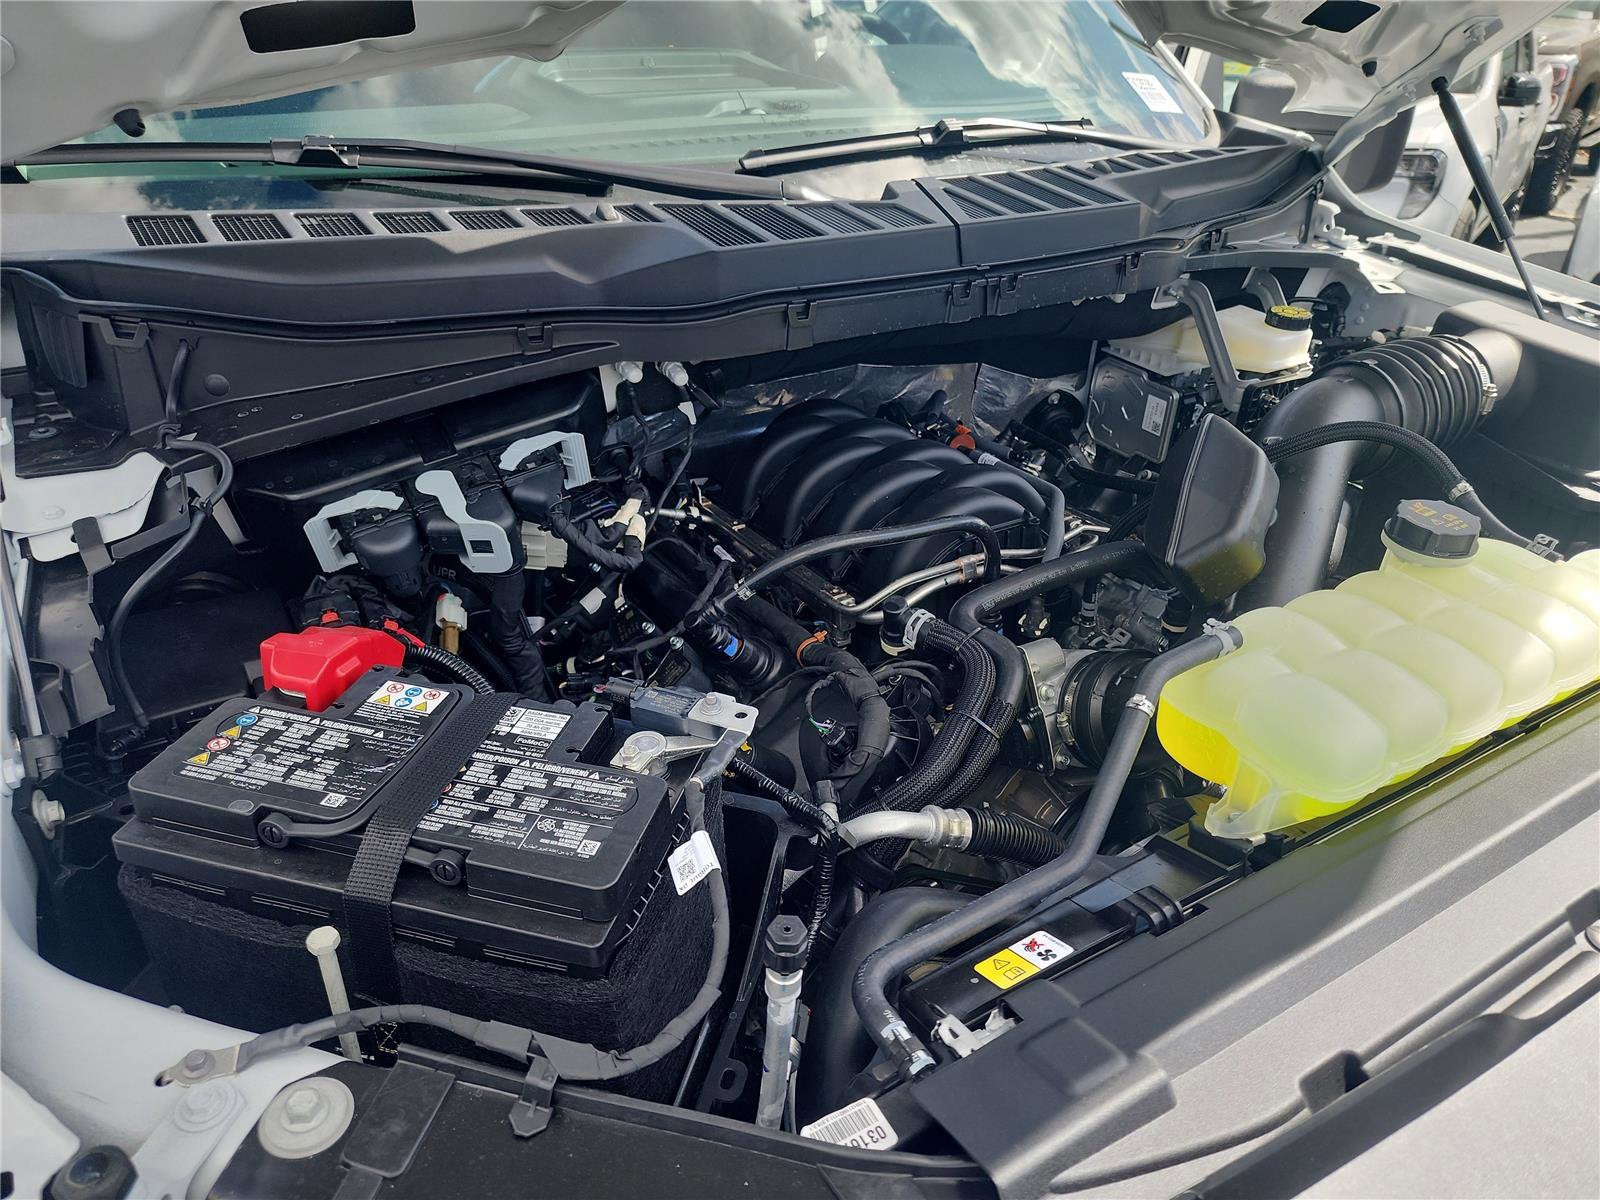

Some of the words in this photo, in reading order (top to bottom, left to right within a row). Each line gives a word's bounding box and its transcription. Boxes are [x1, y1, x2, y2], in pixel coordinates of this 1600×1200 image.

[320, 720, 375, 735] PELIGRO/VENENO
[517, 738, 549, 747] FoMoCo
[471, 752, 520, 765] ANGER/POISON
[531, 762, 589, 777] PELIGRO/VENENO
[844, 1125, 886, 1149] 0316
